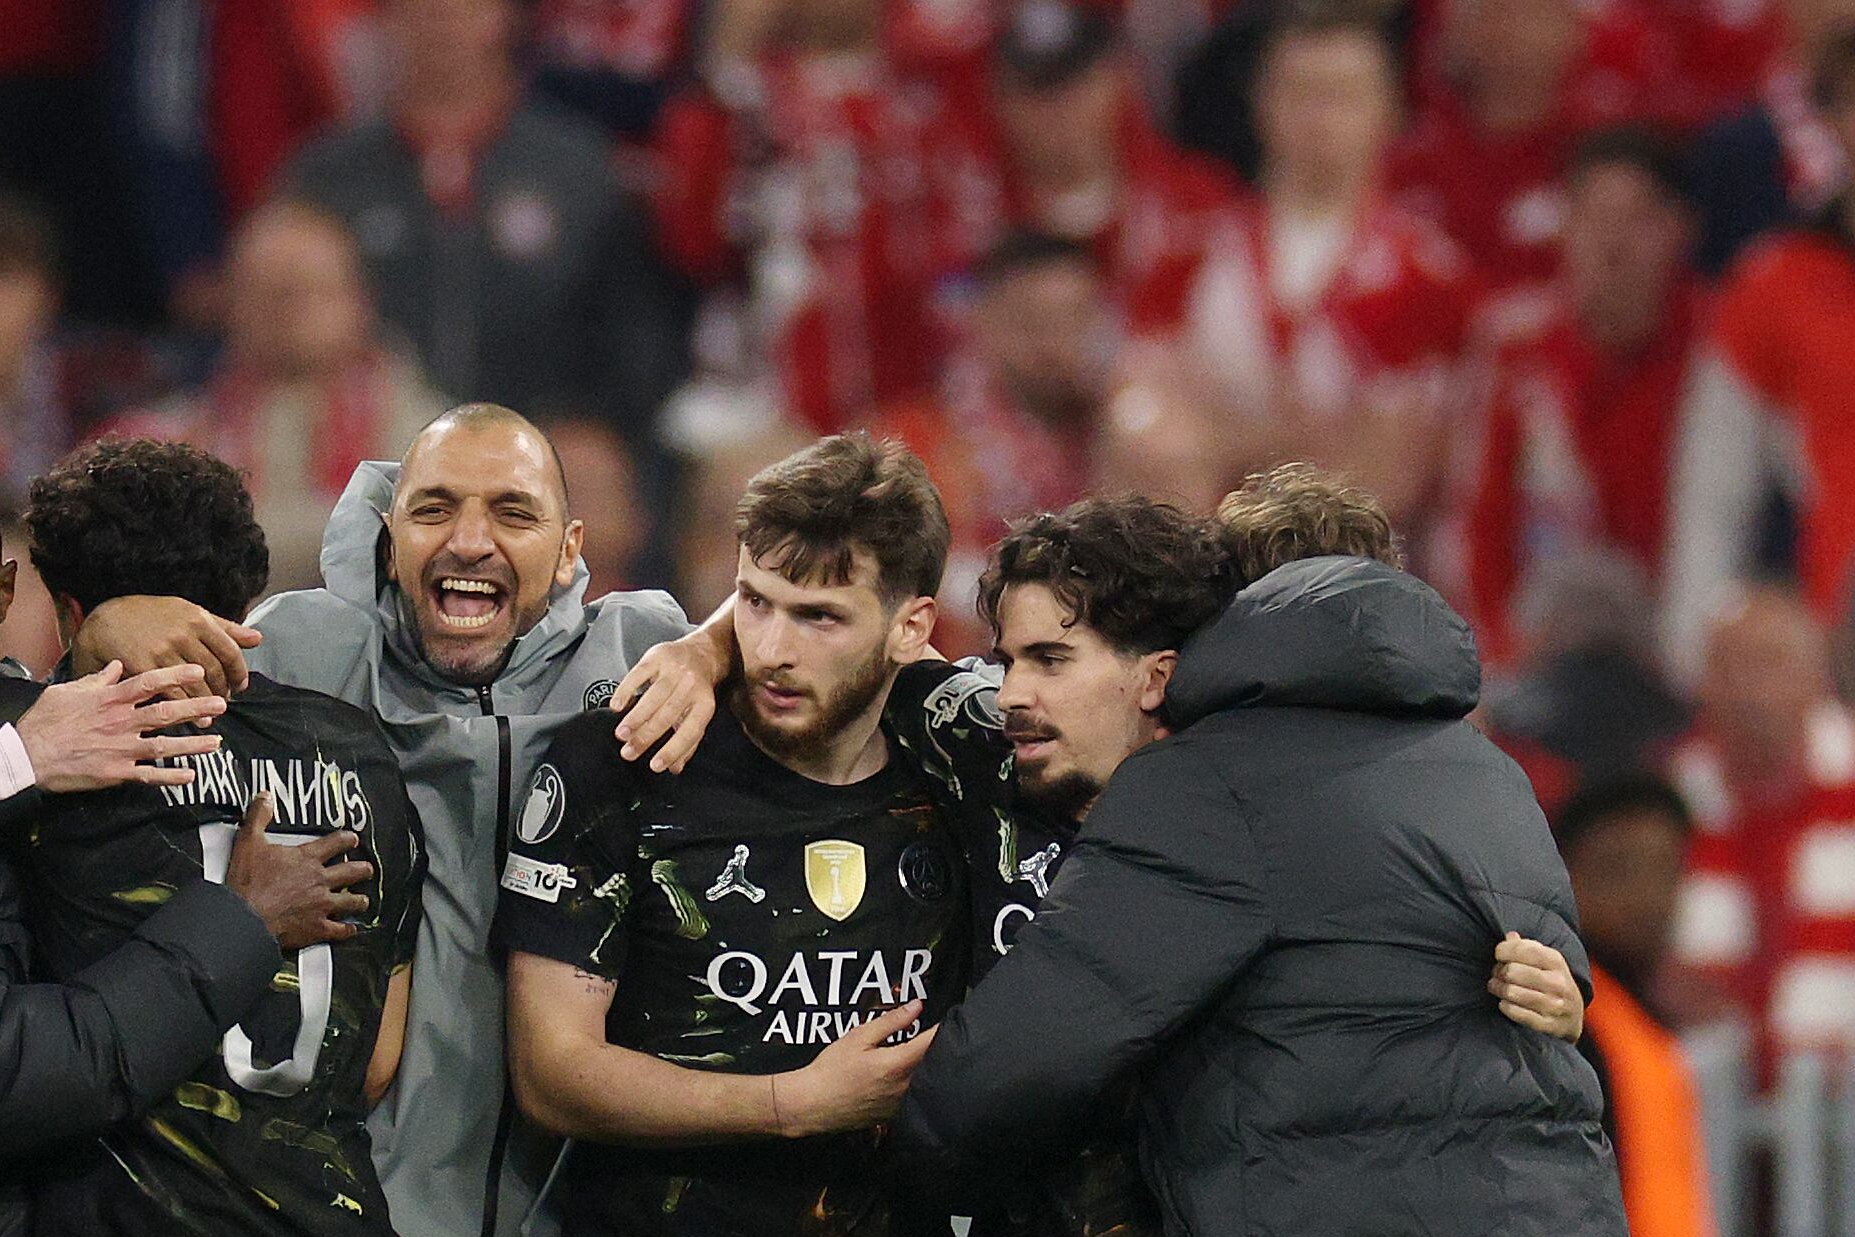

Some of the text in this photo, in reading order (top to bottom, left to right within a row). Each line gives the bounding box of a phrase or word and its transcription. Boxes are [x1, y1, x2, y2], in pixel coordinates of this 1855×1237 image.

[589, 684, 617, 705] PARI
[707, 948, 932, 1016] QATAR
[762, 1009, 922, 1045] AIRWS
